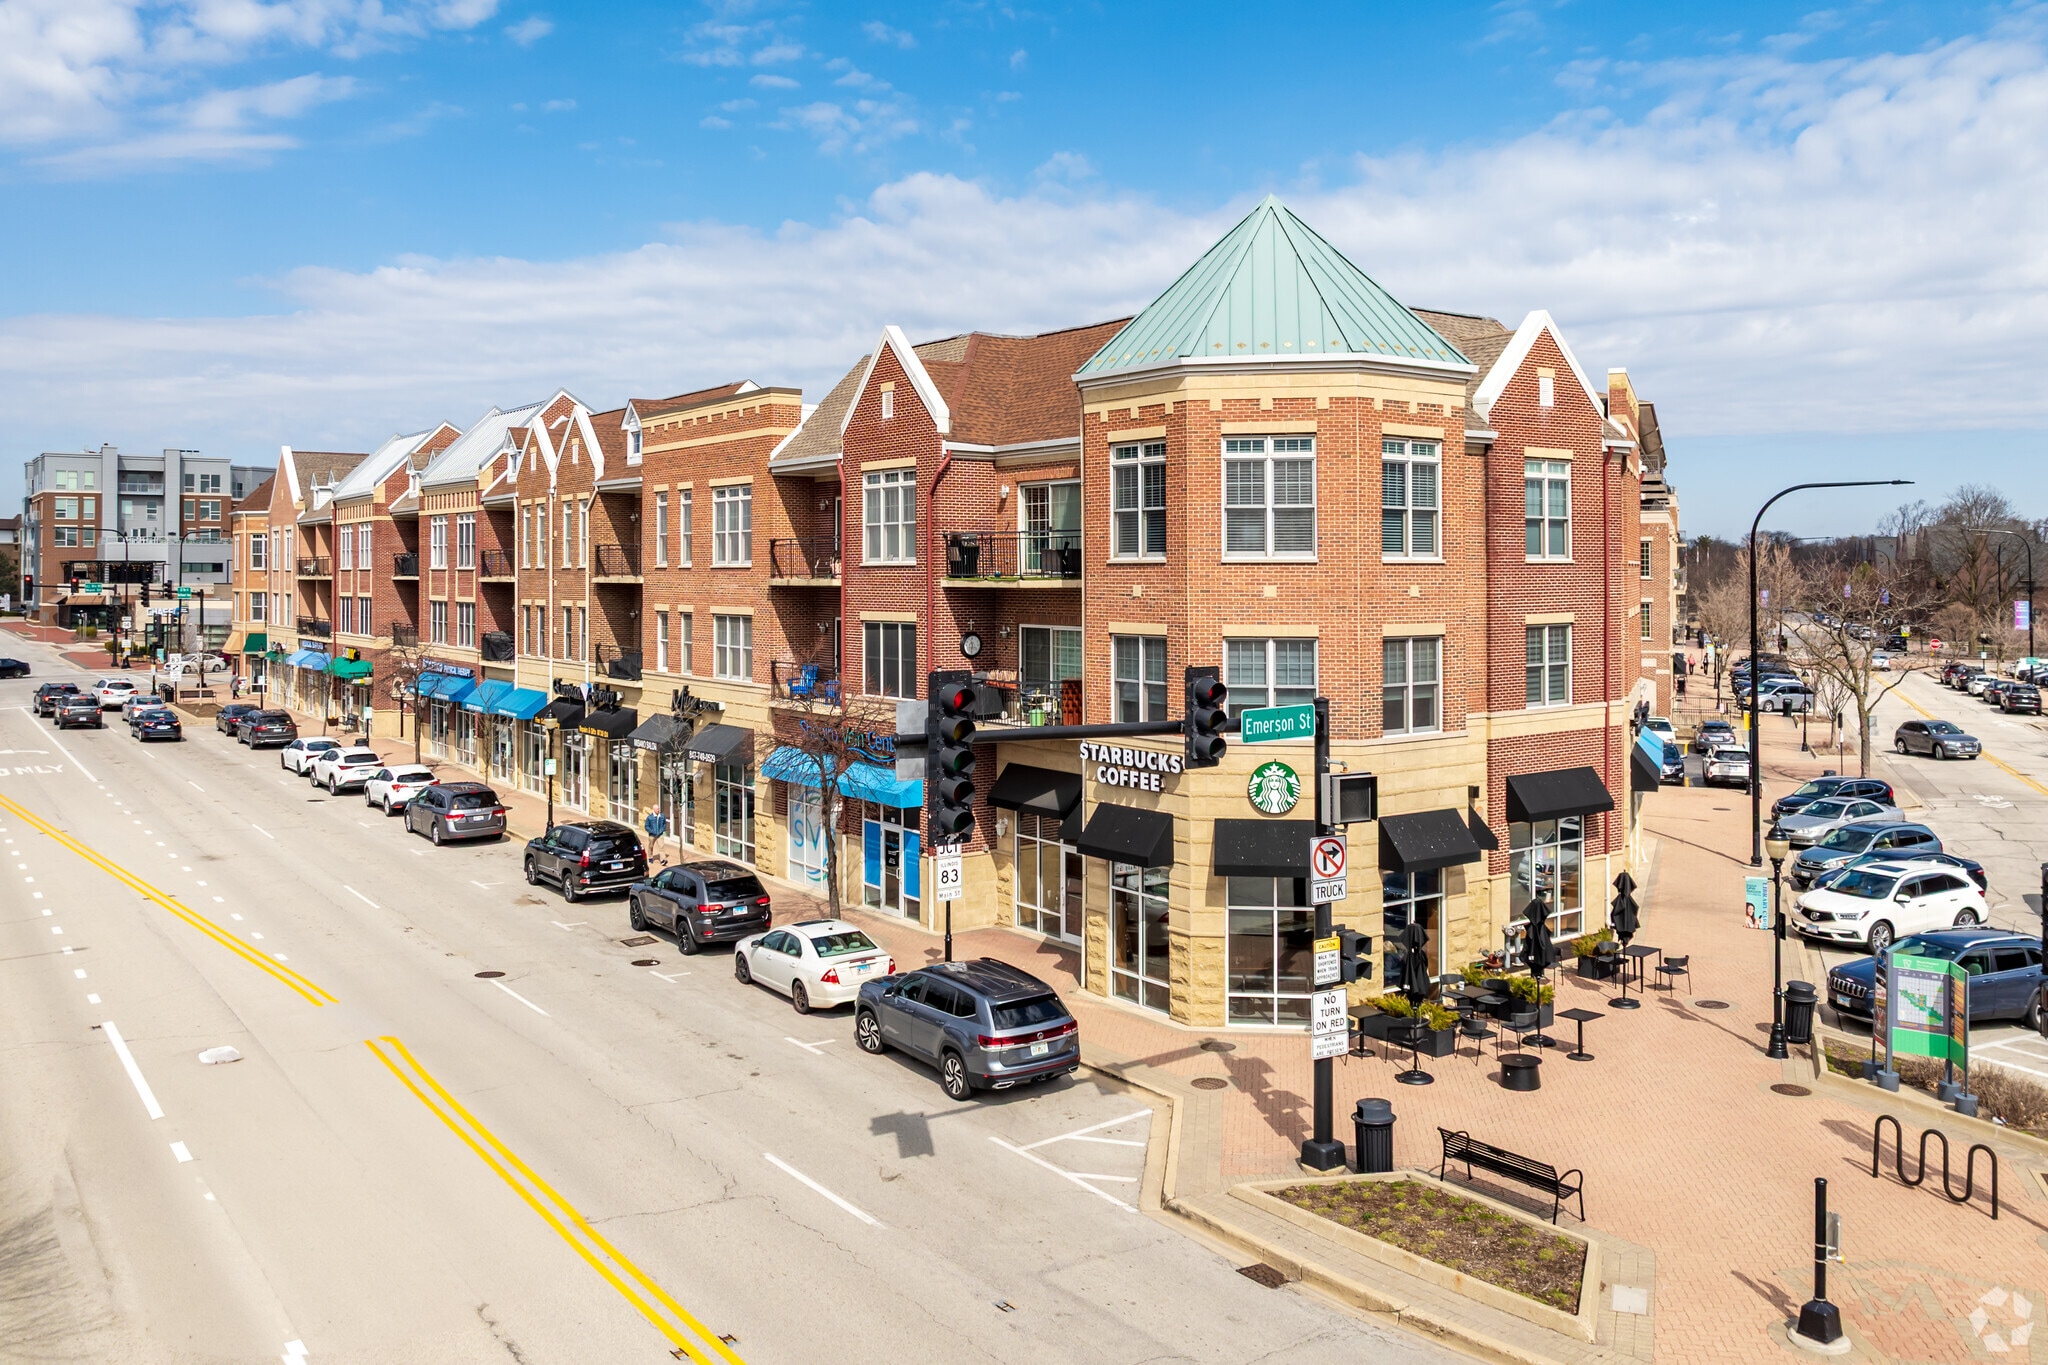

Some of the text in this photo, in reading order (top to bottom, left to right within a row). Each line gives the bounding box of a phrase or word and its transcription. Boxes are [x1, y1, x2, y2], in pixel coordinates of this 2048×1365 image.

[1246, 713, 1311, 735] Emerson St
[867, 731, 897, 753] Cent
[1080, 742, 1181, 774] STARBUCKS
[0, 764, 63, 777] ONLY
[1097, 765, 1160, 792] COFFEE
[941, 869, 959, 884] 83
[1315, 884, 1344, 899] TRUCK
[1318, 942, 1336, 950] CAUTION
[1324, 995, 1336, 1005] NO
[1320, 1007, 1341, 1017] TURN
[1316, 1018, 1345, 1031] ON RED
[1316, 1041, 1344, 1050] PEDESTRIANS
[1326, 1047, 1345, 1056] PRESENT
